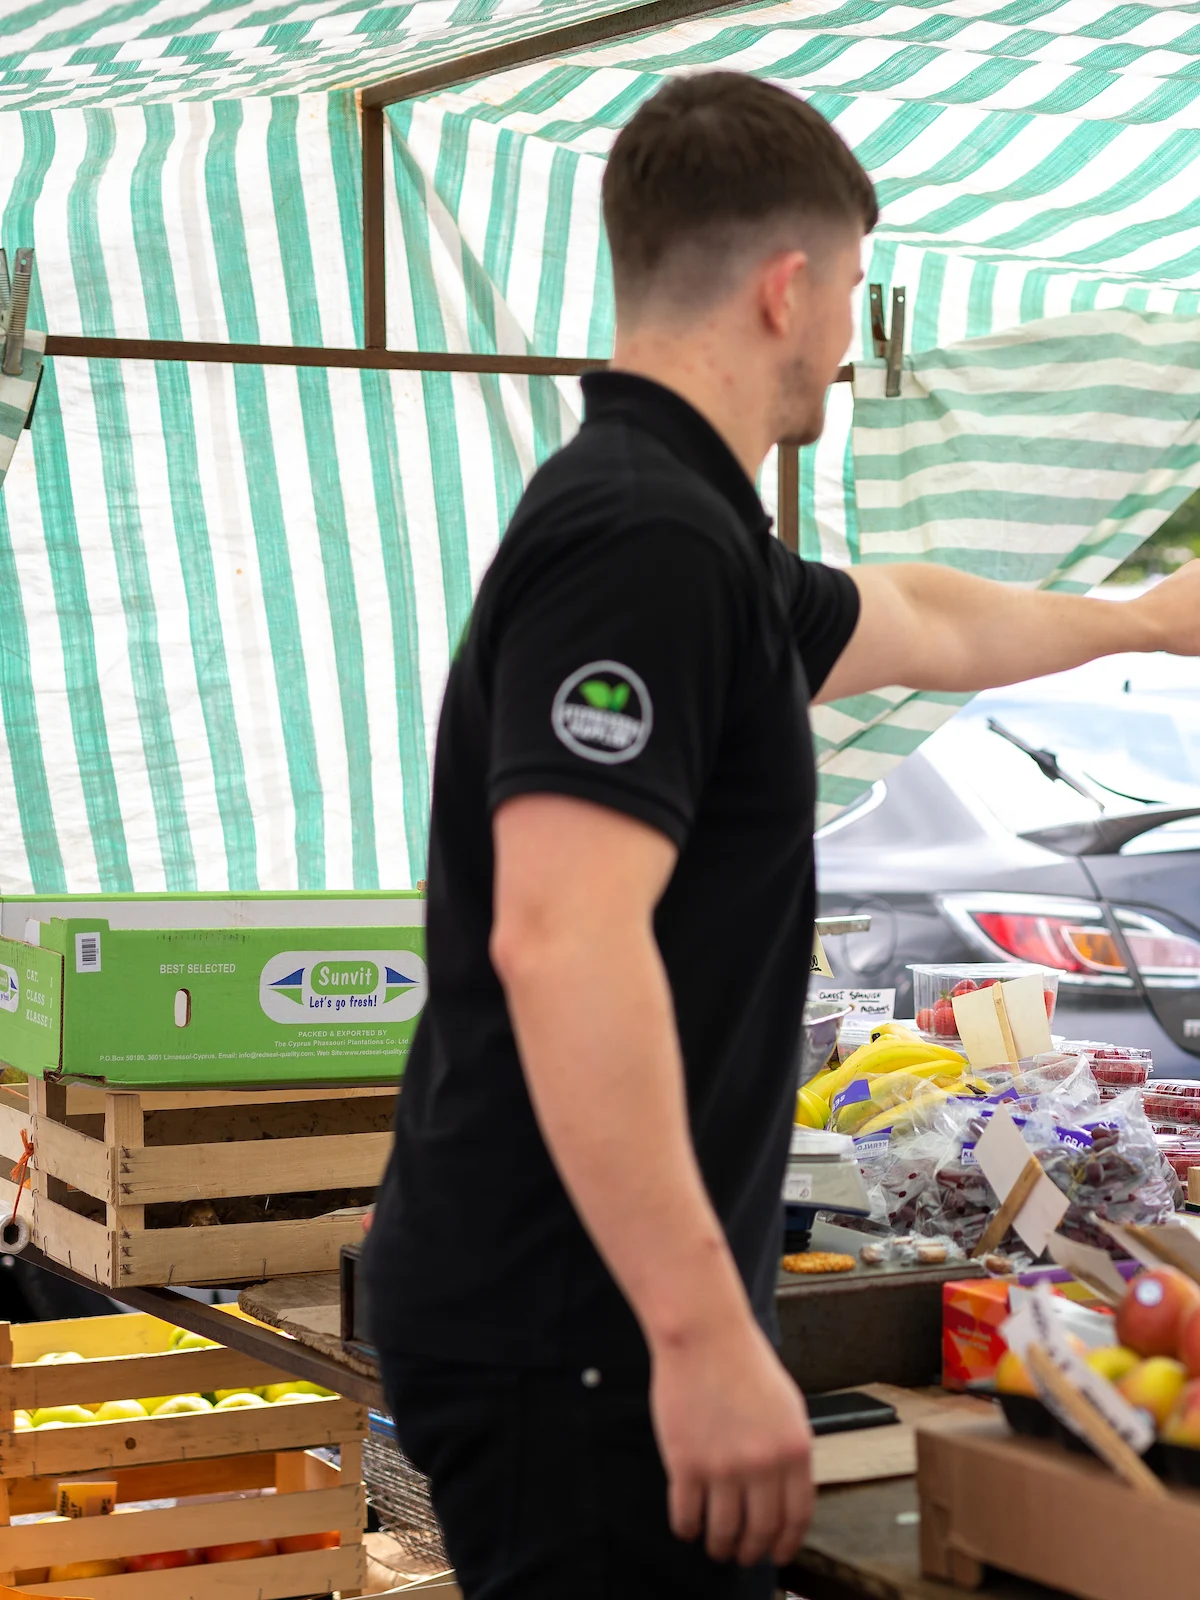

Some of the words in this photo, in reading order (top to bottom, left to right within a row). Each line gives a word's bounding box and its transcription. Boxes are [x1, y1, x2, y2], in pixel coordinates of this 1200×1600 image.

[26, 968, 39, 983] CAT.
[160, 963, 185, 974] BEST
[187, 963, 236, 974] SELECTED
[318, 965, 372, 987] Sunvit
[26, 989, 46, 1006] CLASS
[309, 995, 332, 1009] Let's
[335, 999, 346, 1011] go
[349, 994, 378, 1008] fresh!
[26, 1009, 49, 1028] KLASSE
[298, 1030, 328, 1038] PACKED
[288, 1040, 311, 1048] Cyprus
[331, 1048, 412, 1056] Site:www.redseal-quality.co
